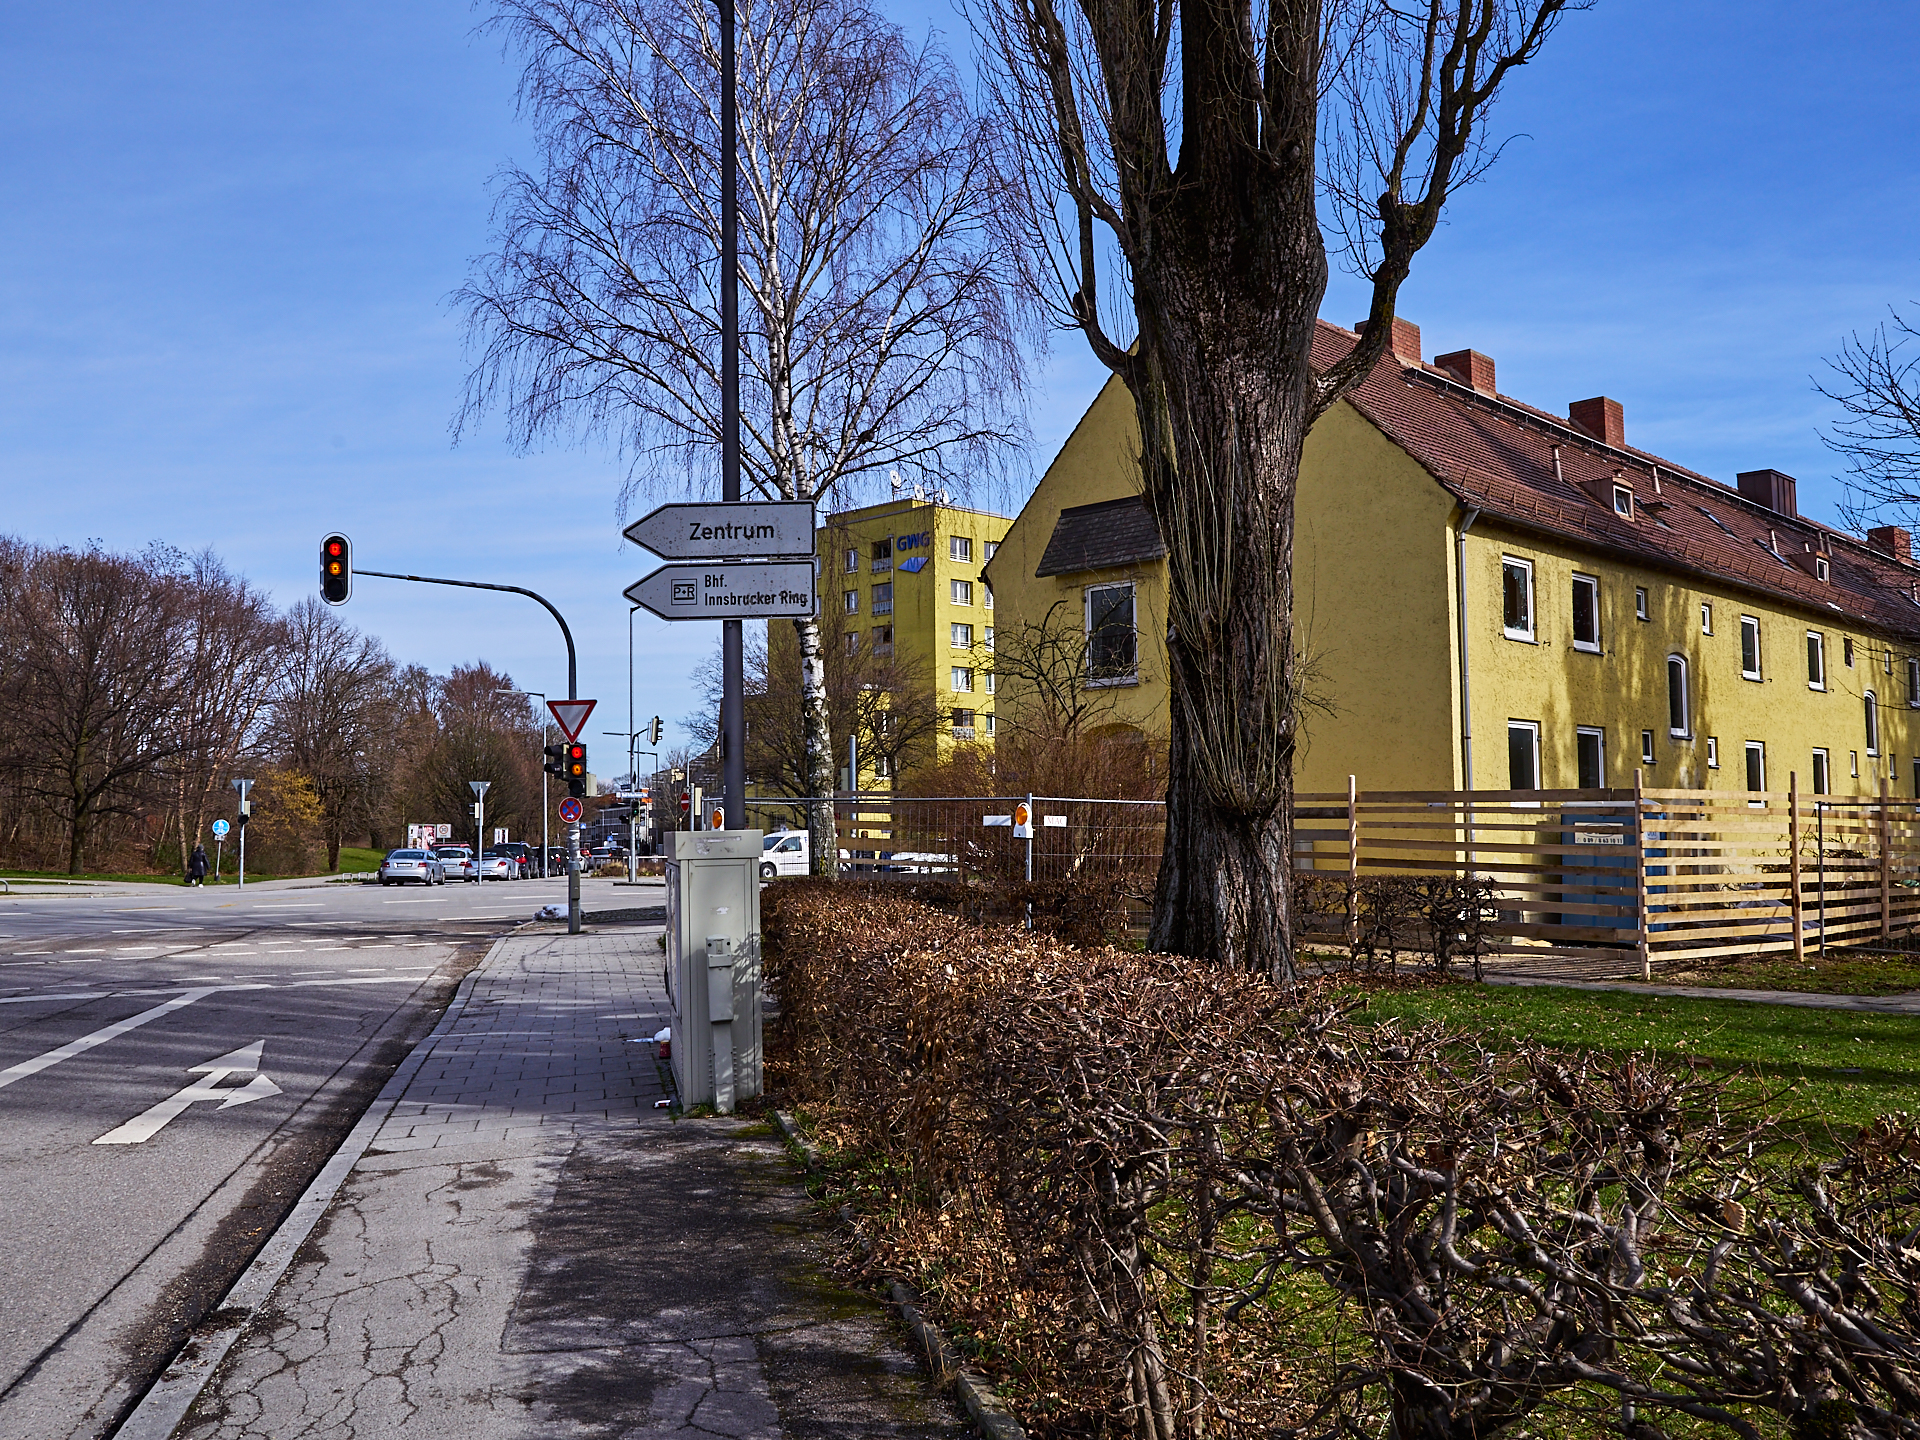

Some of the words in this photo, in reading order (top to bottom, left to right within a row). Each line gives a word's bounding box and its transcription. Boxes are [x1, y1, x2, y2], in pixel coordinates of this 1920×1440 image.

[690, 522, 775, 541] Zentrum
[896, 531, 930, 551] GWG
[704, 574, 728, 588] Bhf.
[673, 586, 695, 597] P+R
[704, 591, 777, 606] Innsbrucker
[779, 590, 808, 607] Ring
